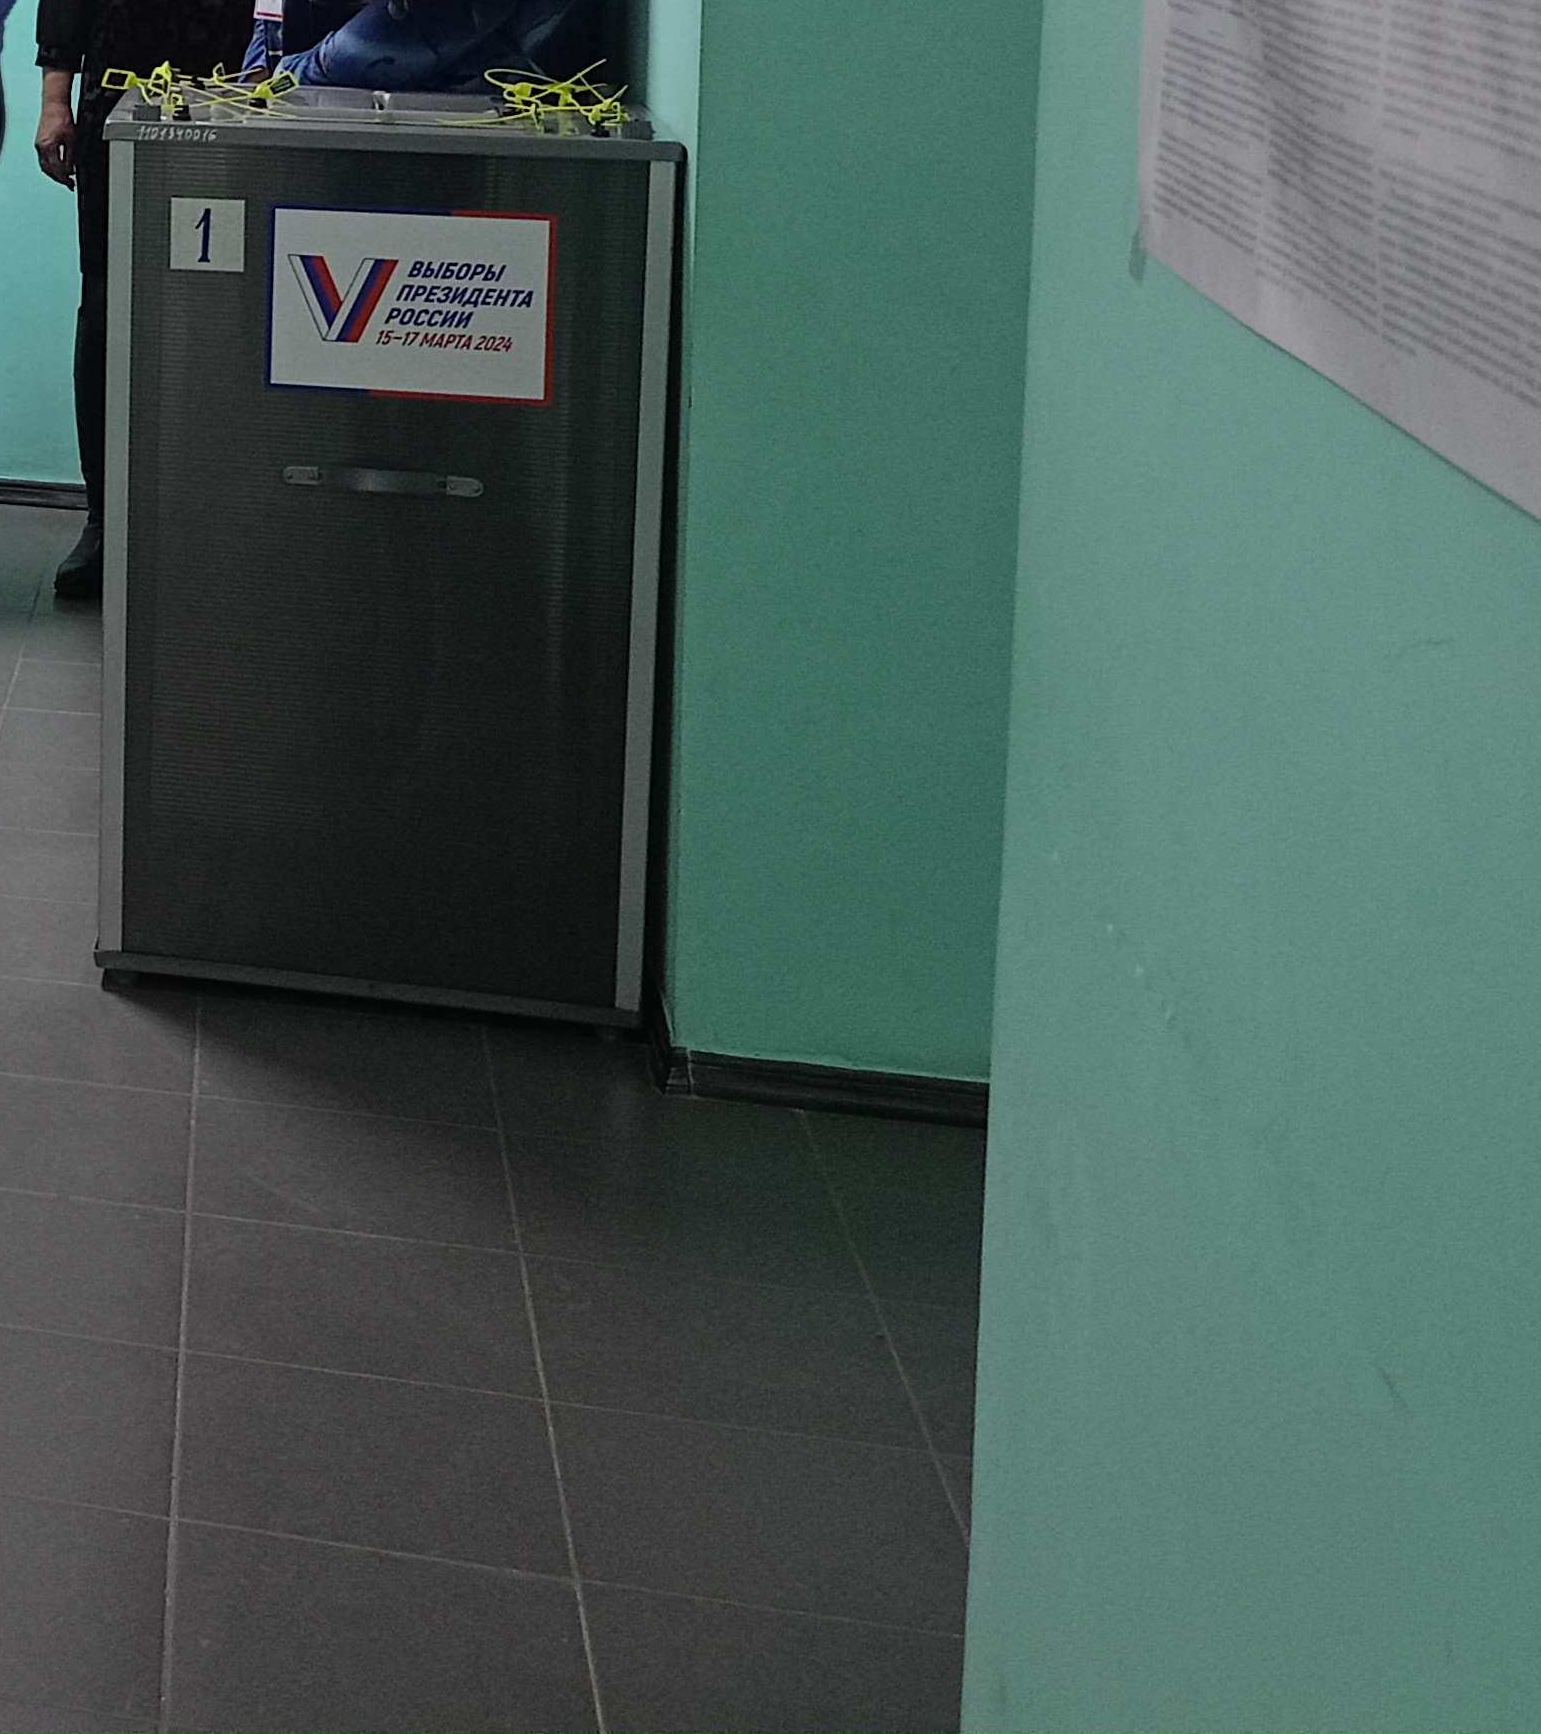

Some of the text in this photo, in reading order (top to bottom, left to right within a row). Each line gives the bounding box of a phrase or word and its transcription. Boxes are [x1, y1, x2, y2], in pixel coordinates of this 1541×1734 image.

[195, 207, 212, 263] 1
[407, 260, 507, 282] ВЫБОРЫ
[395, 284, 534, 308] ПРЕЗИДЕНТА
[384, 307, 475, 329] РОССИИ
[419, 332, 474, 350] МАРТА
[473, 335, 514, 352] 2024
